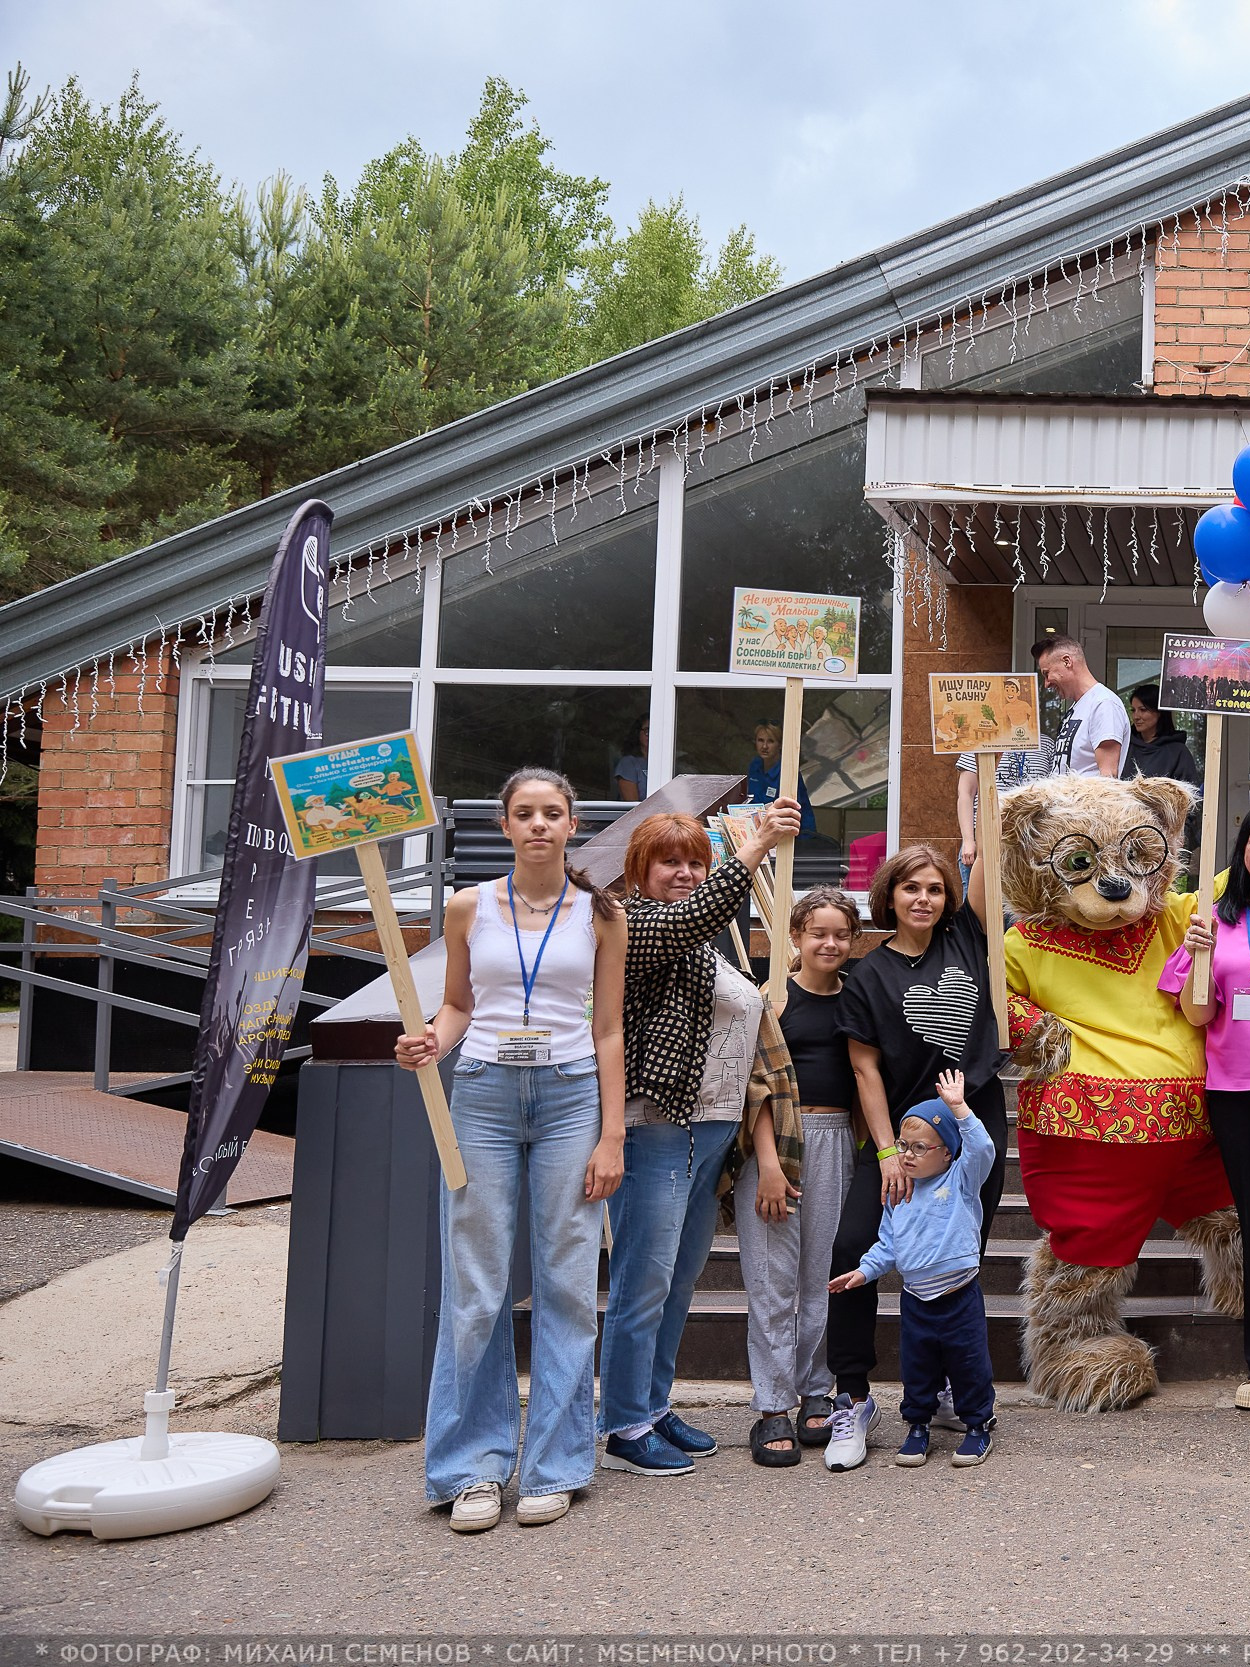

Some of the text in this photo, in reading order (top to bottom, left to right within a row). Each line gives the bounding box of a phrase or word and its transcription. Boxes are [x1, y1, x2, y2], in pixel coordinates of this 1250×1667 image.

[743, 594, 849, 609] Не нужно заграничных
[772, 605, 819, 616] Мальдив
[1168, 639, 1226, 649] ГДЕ ЛУЧШИЕ
[938, 680, 991, 692] ИЩУ ПАРУ
[946, 692, 986, 702] В САУНУ
[1233, 689, 1239, 697] У
[328, 748, 360, 762] ОТДЫХ
[308, 768, 340, 781] только
[350, 758, 392, 772] кефиром
[315, 764, 328, 773] All
